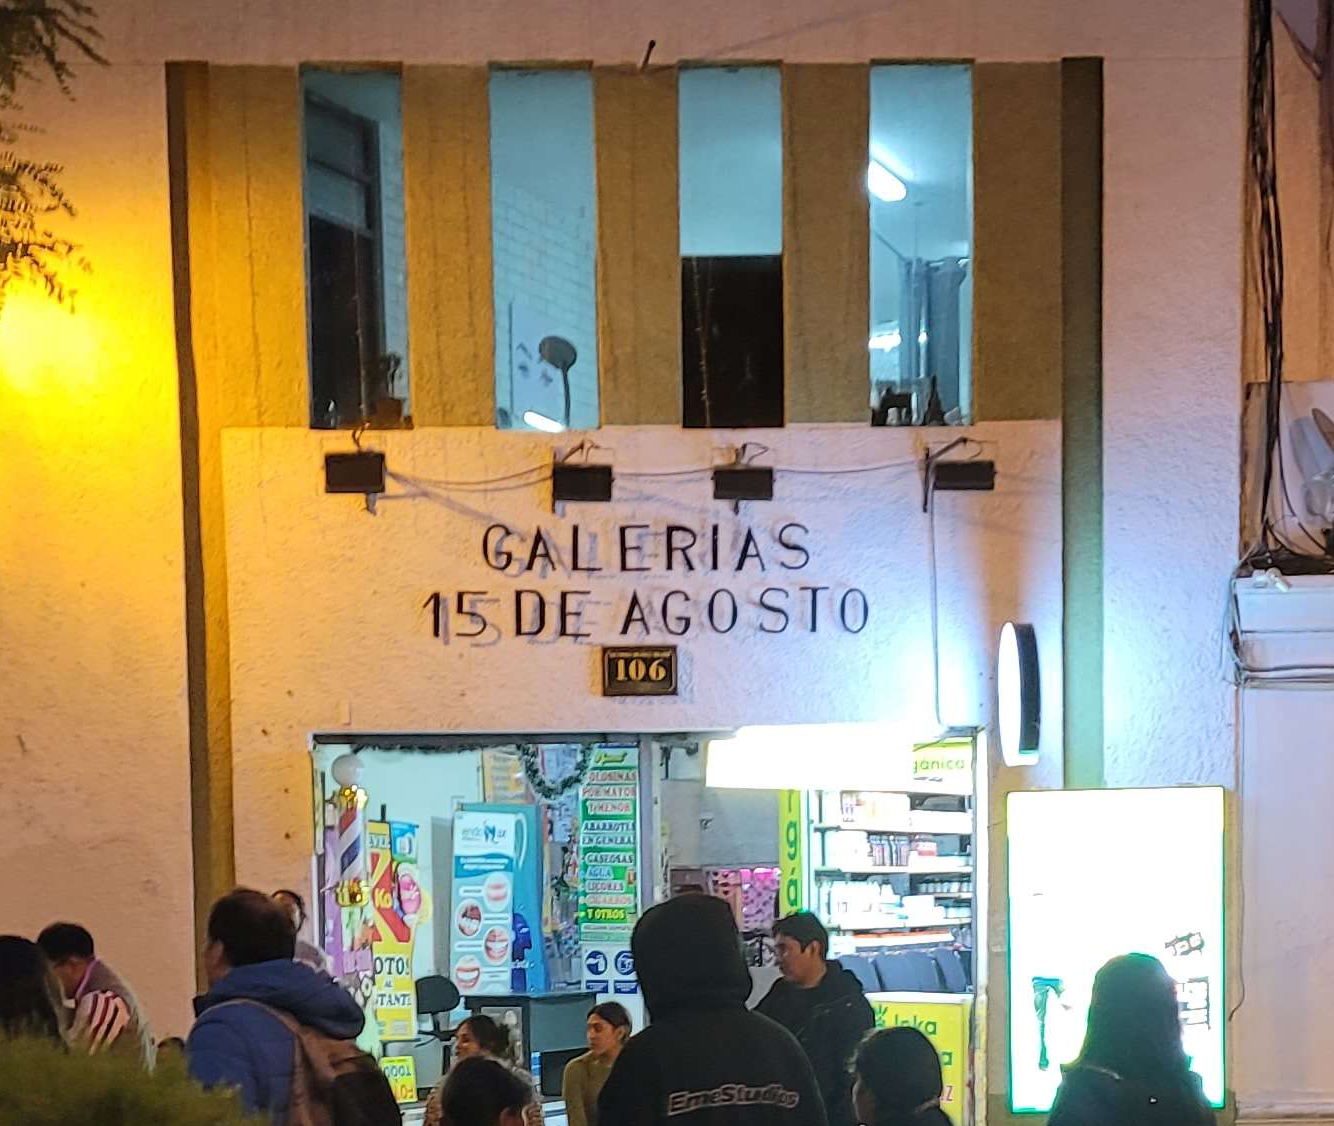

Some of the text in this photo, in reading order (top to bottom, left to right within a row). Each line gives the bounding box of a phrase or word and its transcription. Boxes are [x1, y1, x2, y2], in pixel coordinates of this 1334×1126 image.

[482, 523, 811, 572] GALERIAS
[422, 587, 868, 637] 15 DE AGOSTO
[618, 658, 667, 681] 106
